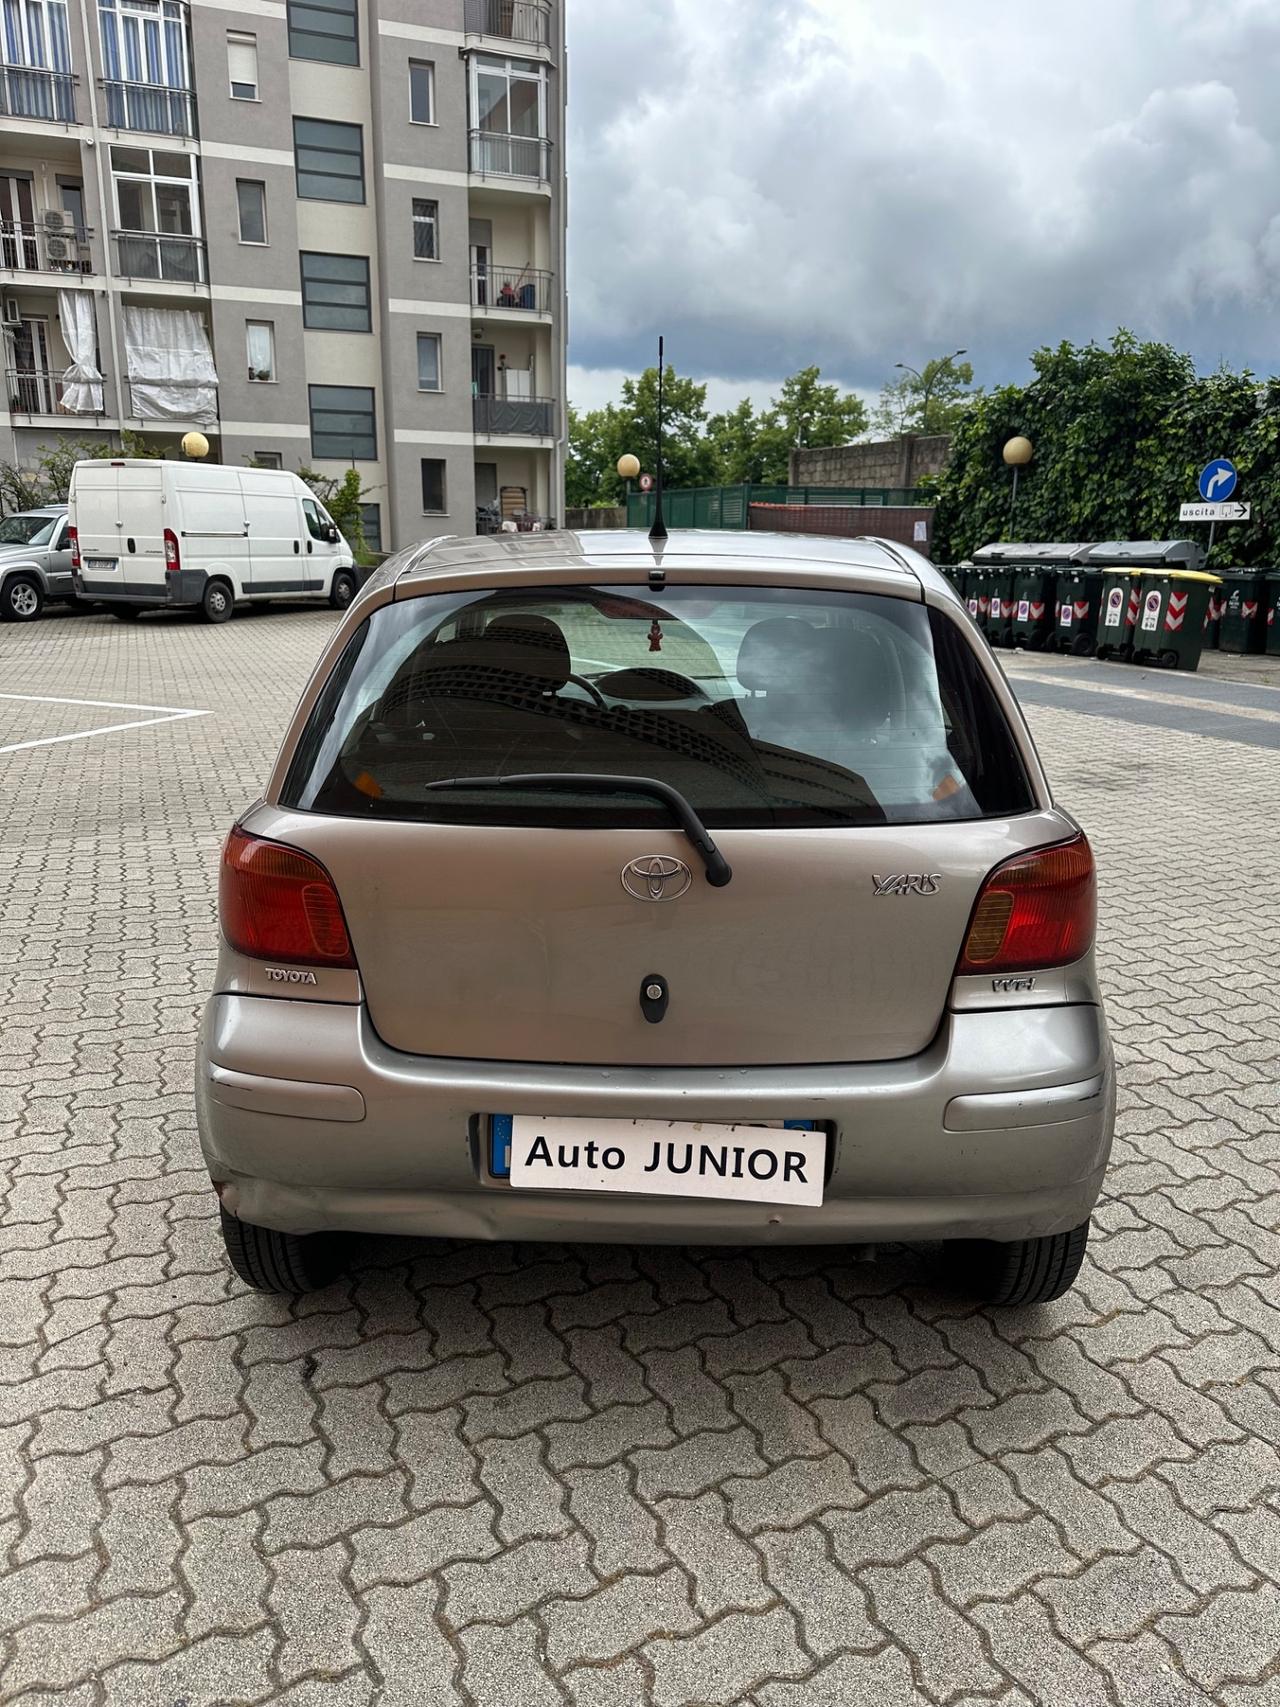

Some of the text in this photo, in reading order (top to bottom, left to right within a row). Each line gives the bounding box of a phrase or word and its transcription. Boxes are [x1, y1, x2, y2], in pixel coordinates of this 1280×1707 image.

[1182, 507, 1216, 517] uscita
[872, 873, 942, 896] YARIS
[265, 967, 317, 985] TOYOTA
[525, 1135, 809, 1184] Auto JUNIOR
